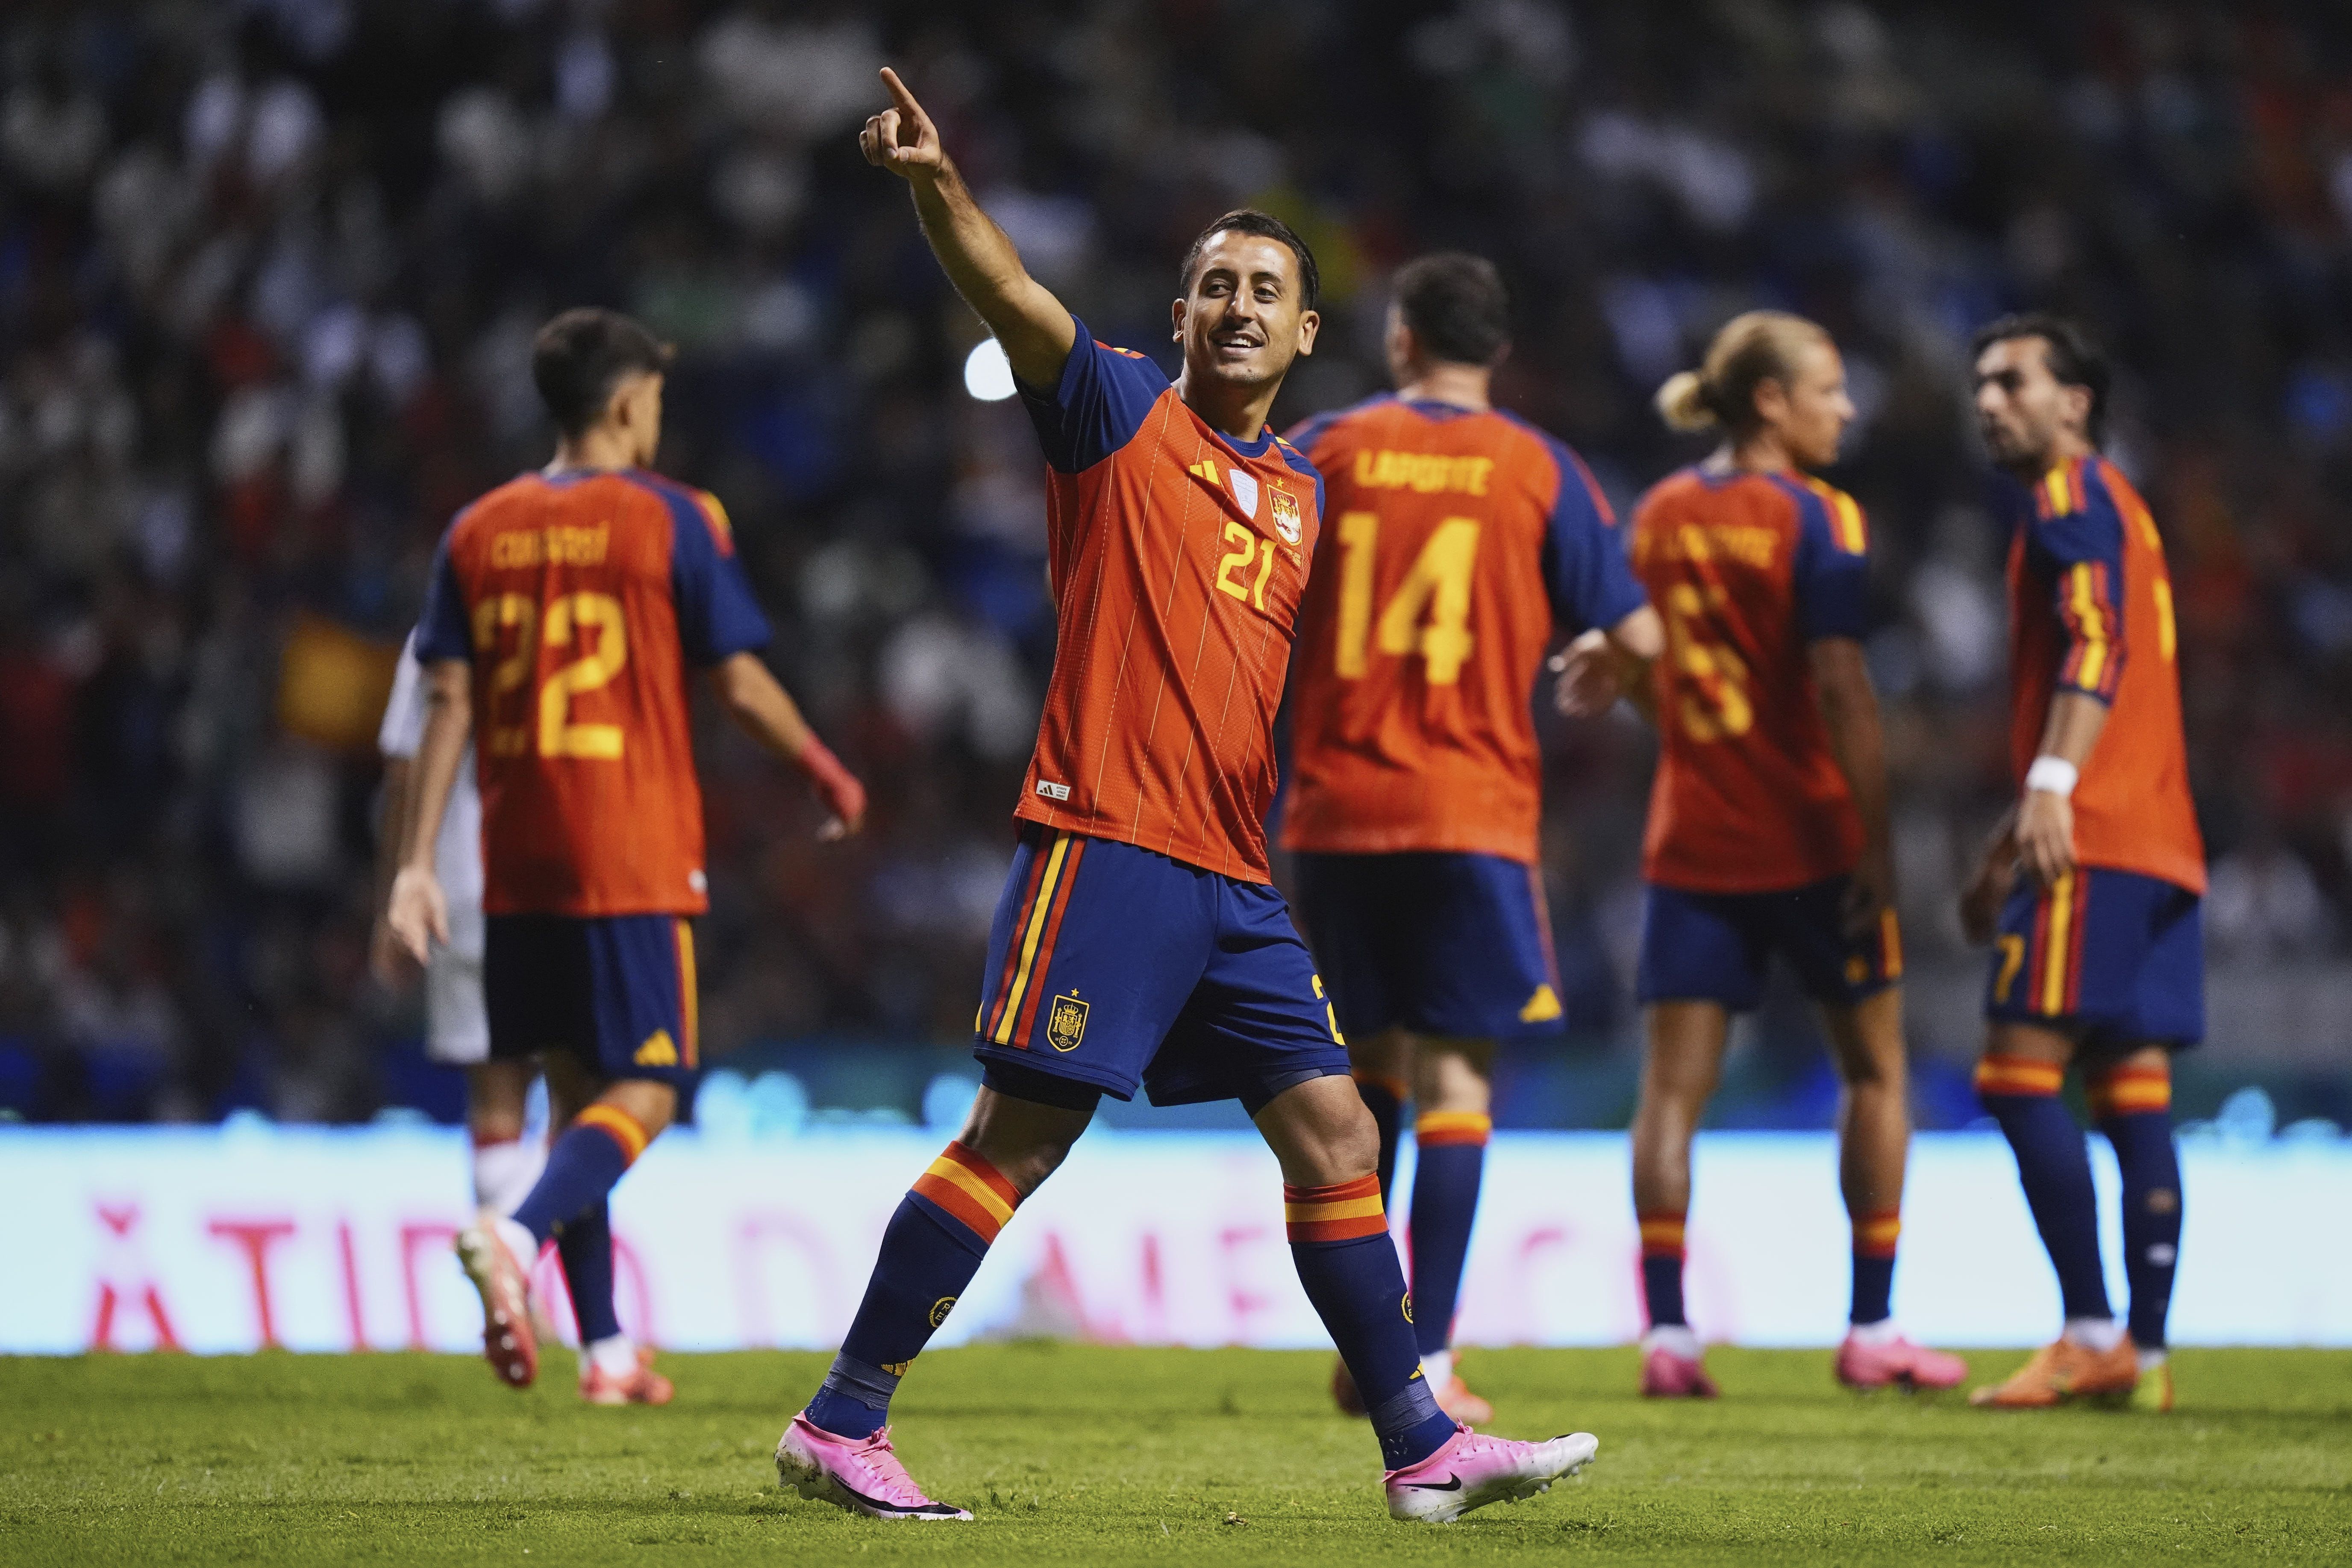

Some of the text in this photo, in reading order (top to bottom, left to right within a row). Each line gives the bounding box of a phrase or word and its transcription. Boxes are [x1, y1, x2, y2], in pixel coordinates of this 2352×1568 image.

[1216, 521, 1277, 611] 21
[1336, 512, 1479, 685] 14
[472, 591, 627, 759] 22
[1996, 933, 2025, 1003] 7
